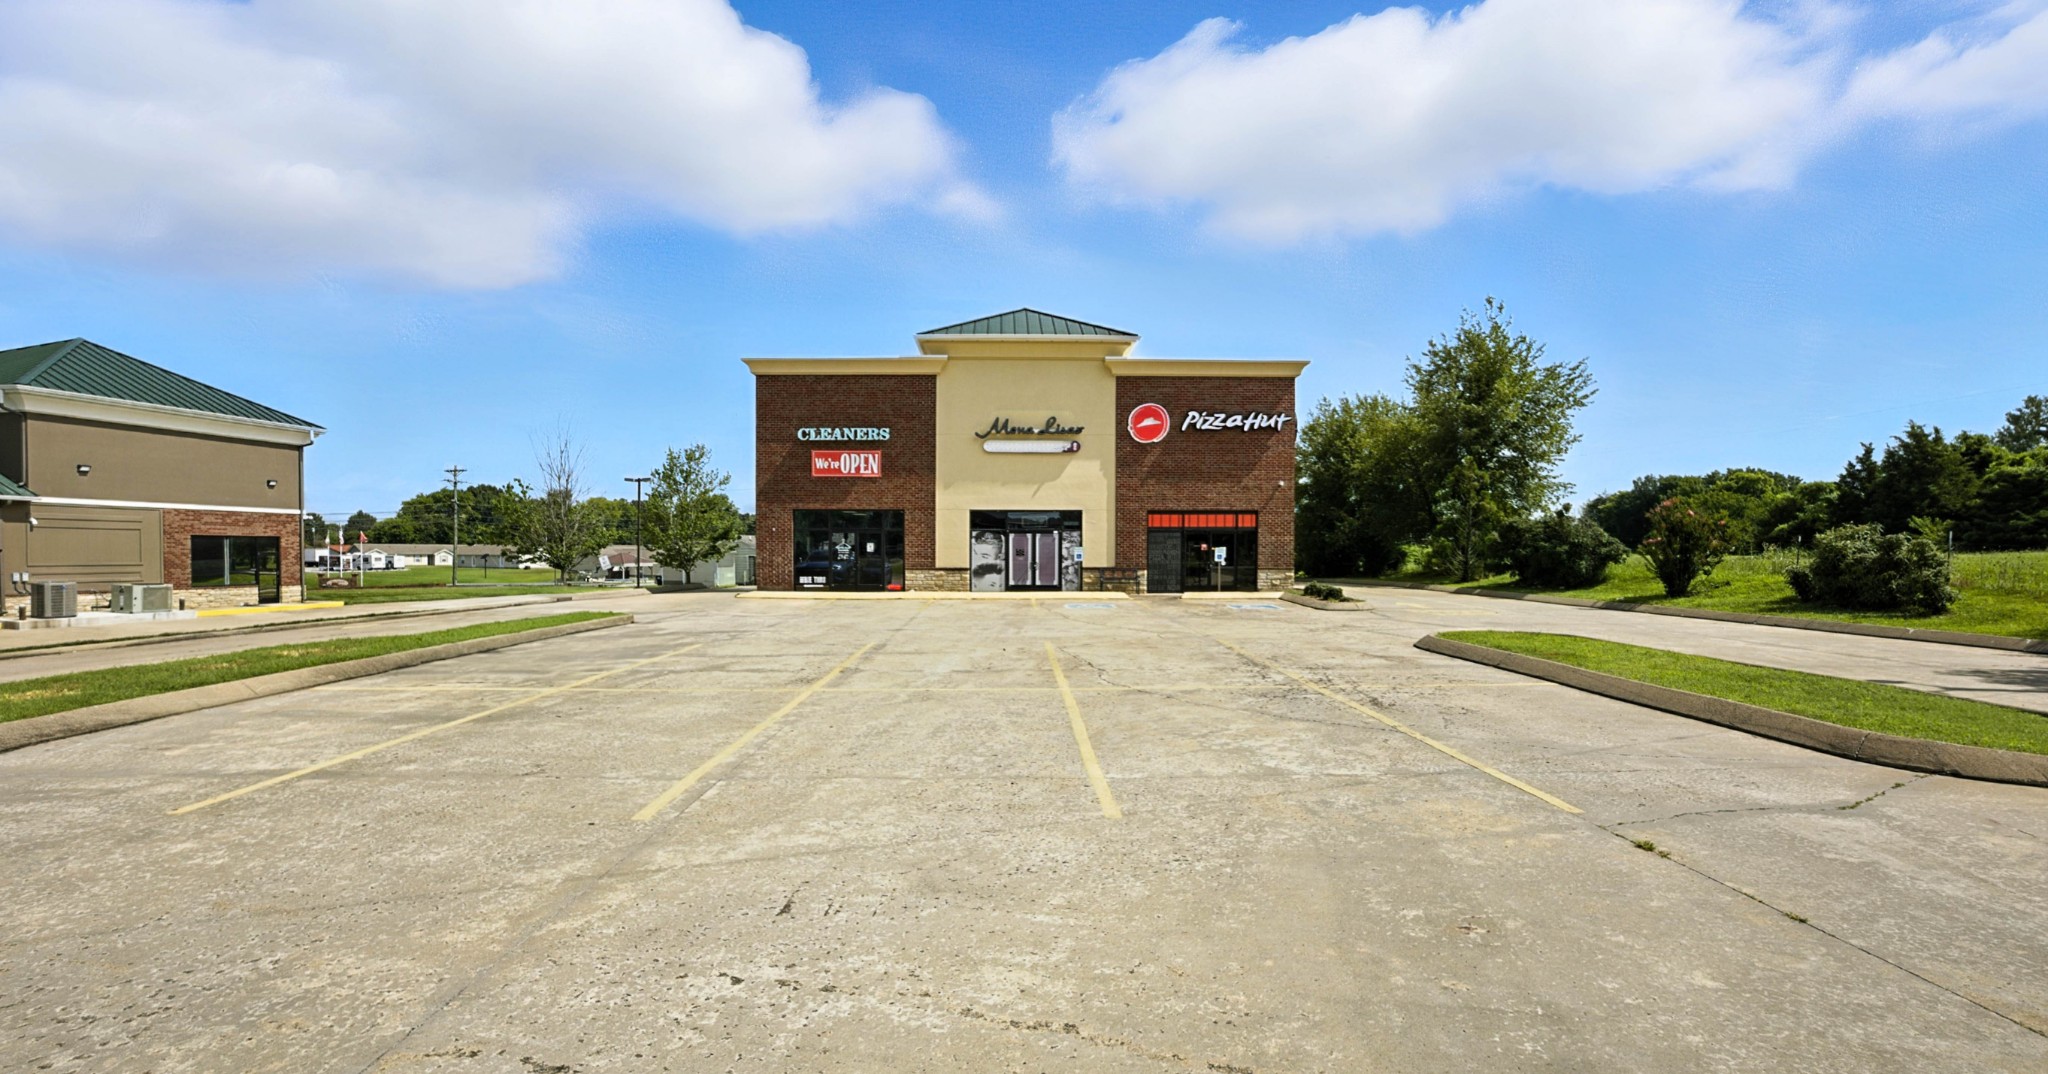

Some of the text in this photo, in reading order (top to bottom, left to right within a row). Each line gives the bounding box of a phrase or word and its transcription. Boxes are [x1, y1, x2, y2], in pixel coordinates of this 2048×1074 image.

[797, 427, 891, 441] CLEANERS
[815, 453, 879, 474] We're OPEN
